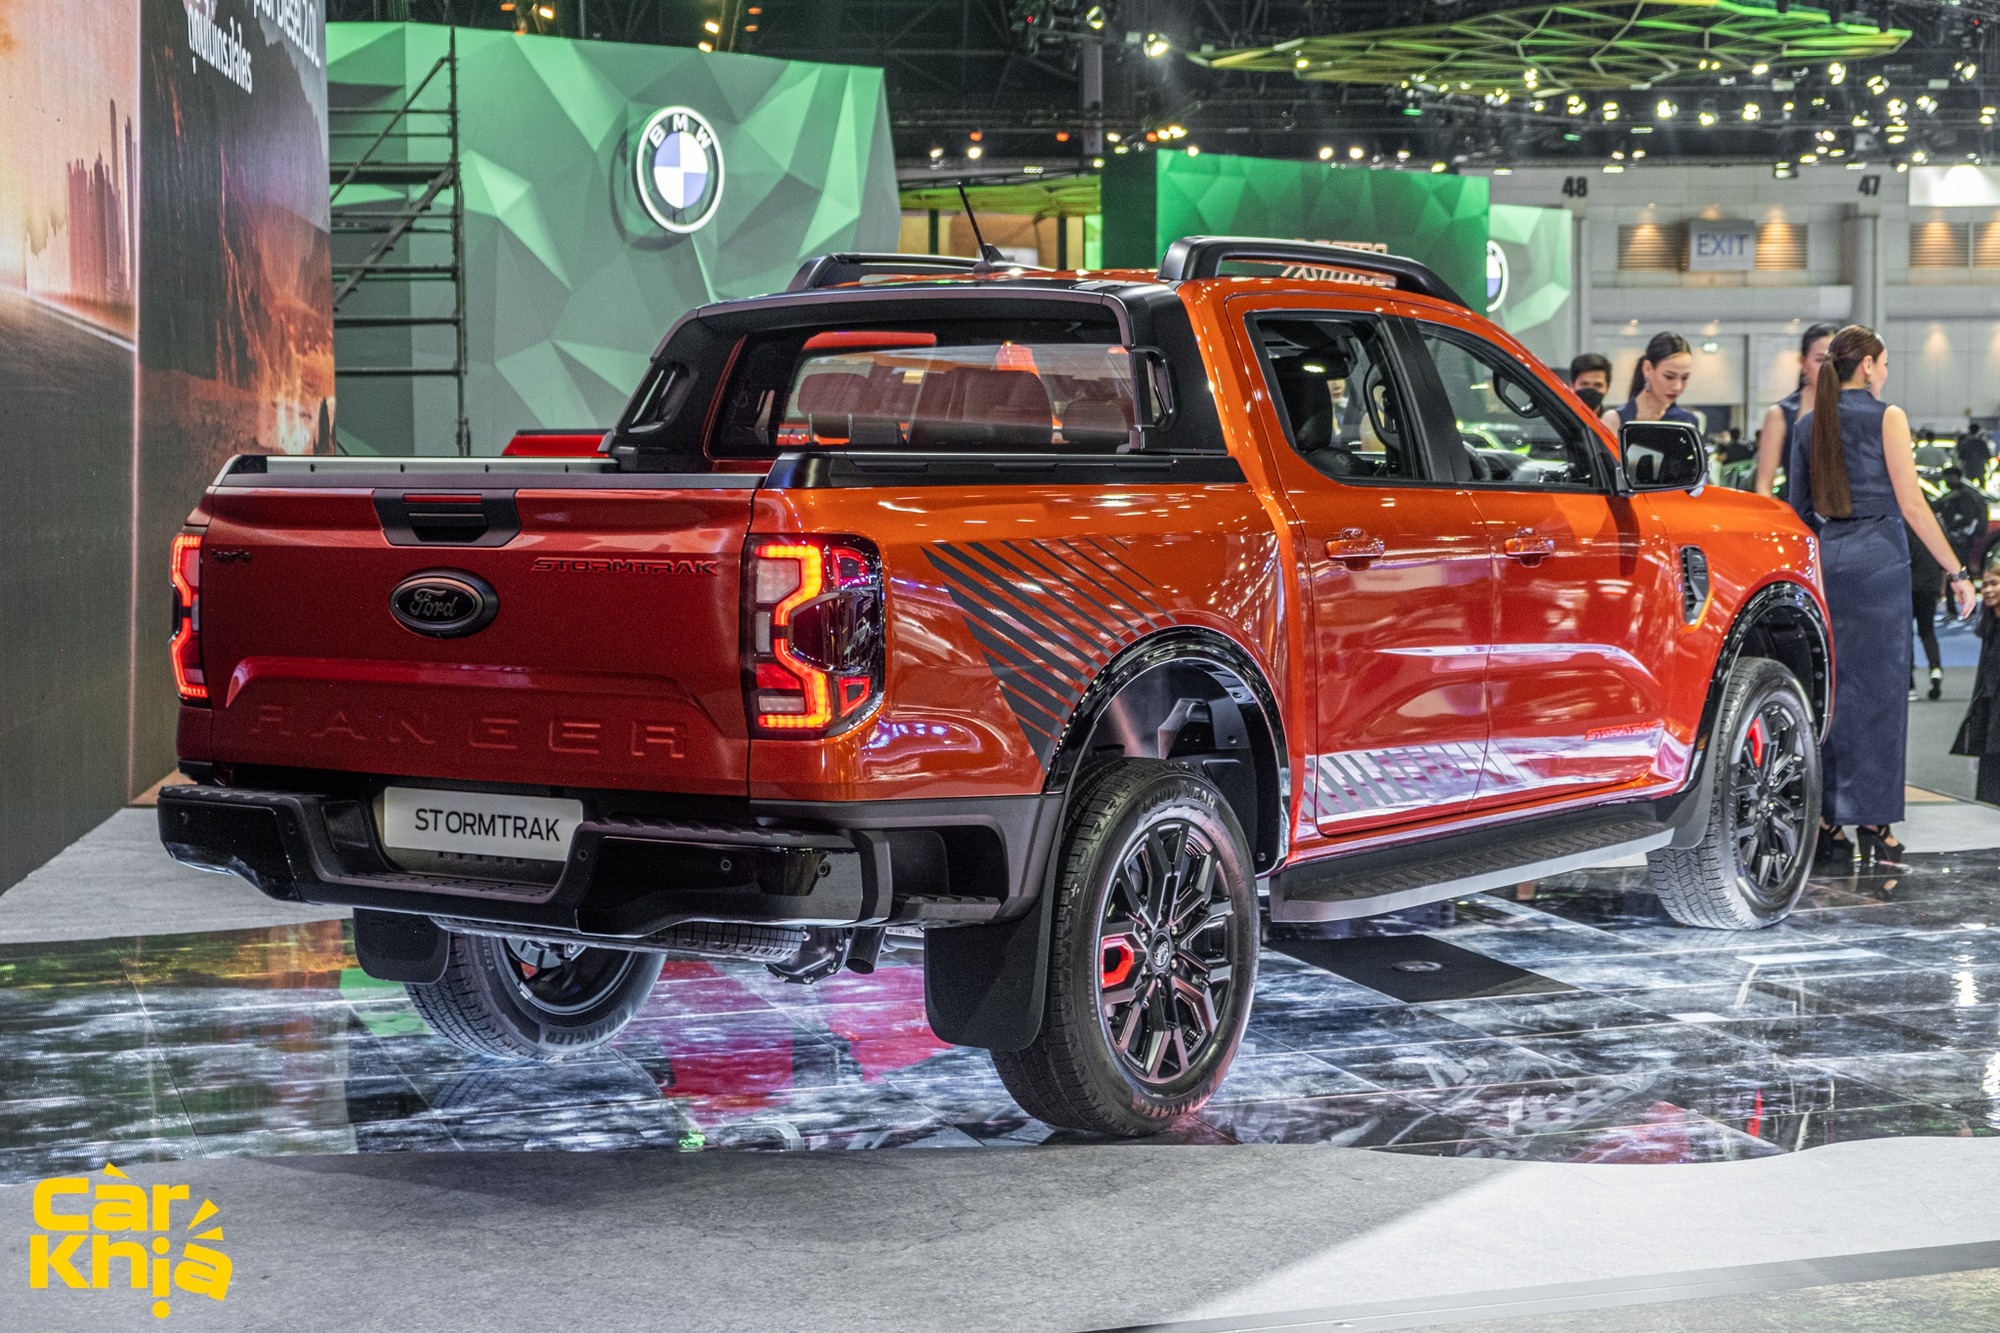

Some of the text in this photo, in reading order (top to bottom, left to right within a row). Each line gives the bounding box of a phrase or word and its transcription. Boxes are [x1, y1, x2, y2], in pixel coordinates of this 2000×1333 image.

[649, 114, 713, 149] BMW
[1562, 175, 1588, 197] 48
[1858, 174, 1881, 195] 47
[1697, 233, 1749, 256] EXIT
[531, 556, 721, 577] STORMTRAK
[409, 588, 459, 617] Ford
[249, 703, 688, 760] RANGER
[415, 808, 561, 842] STORMTRAK
